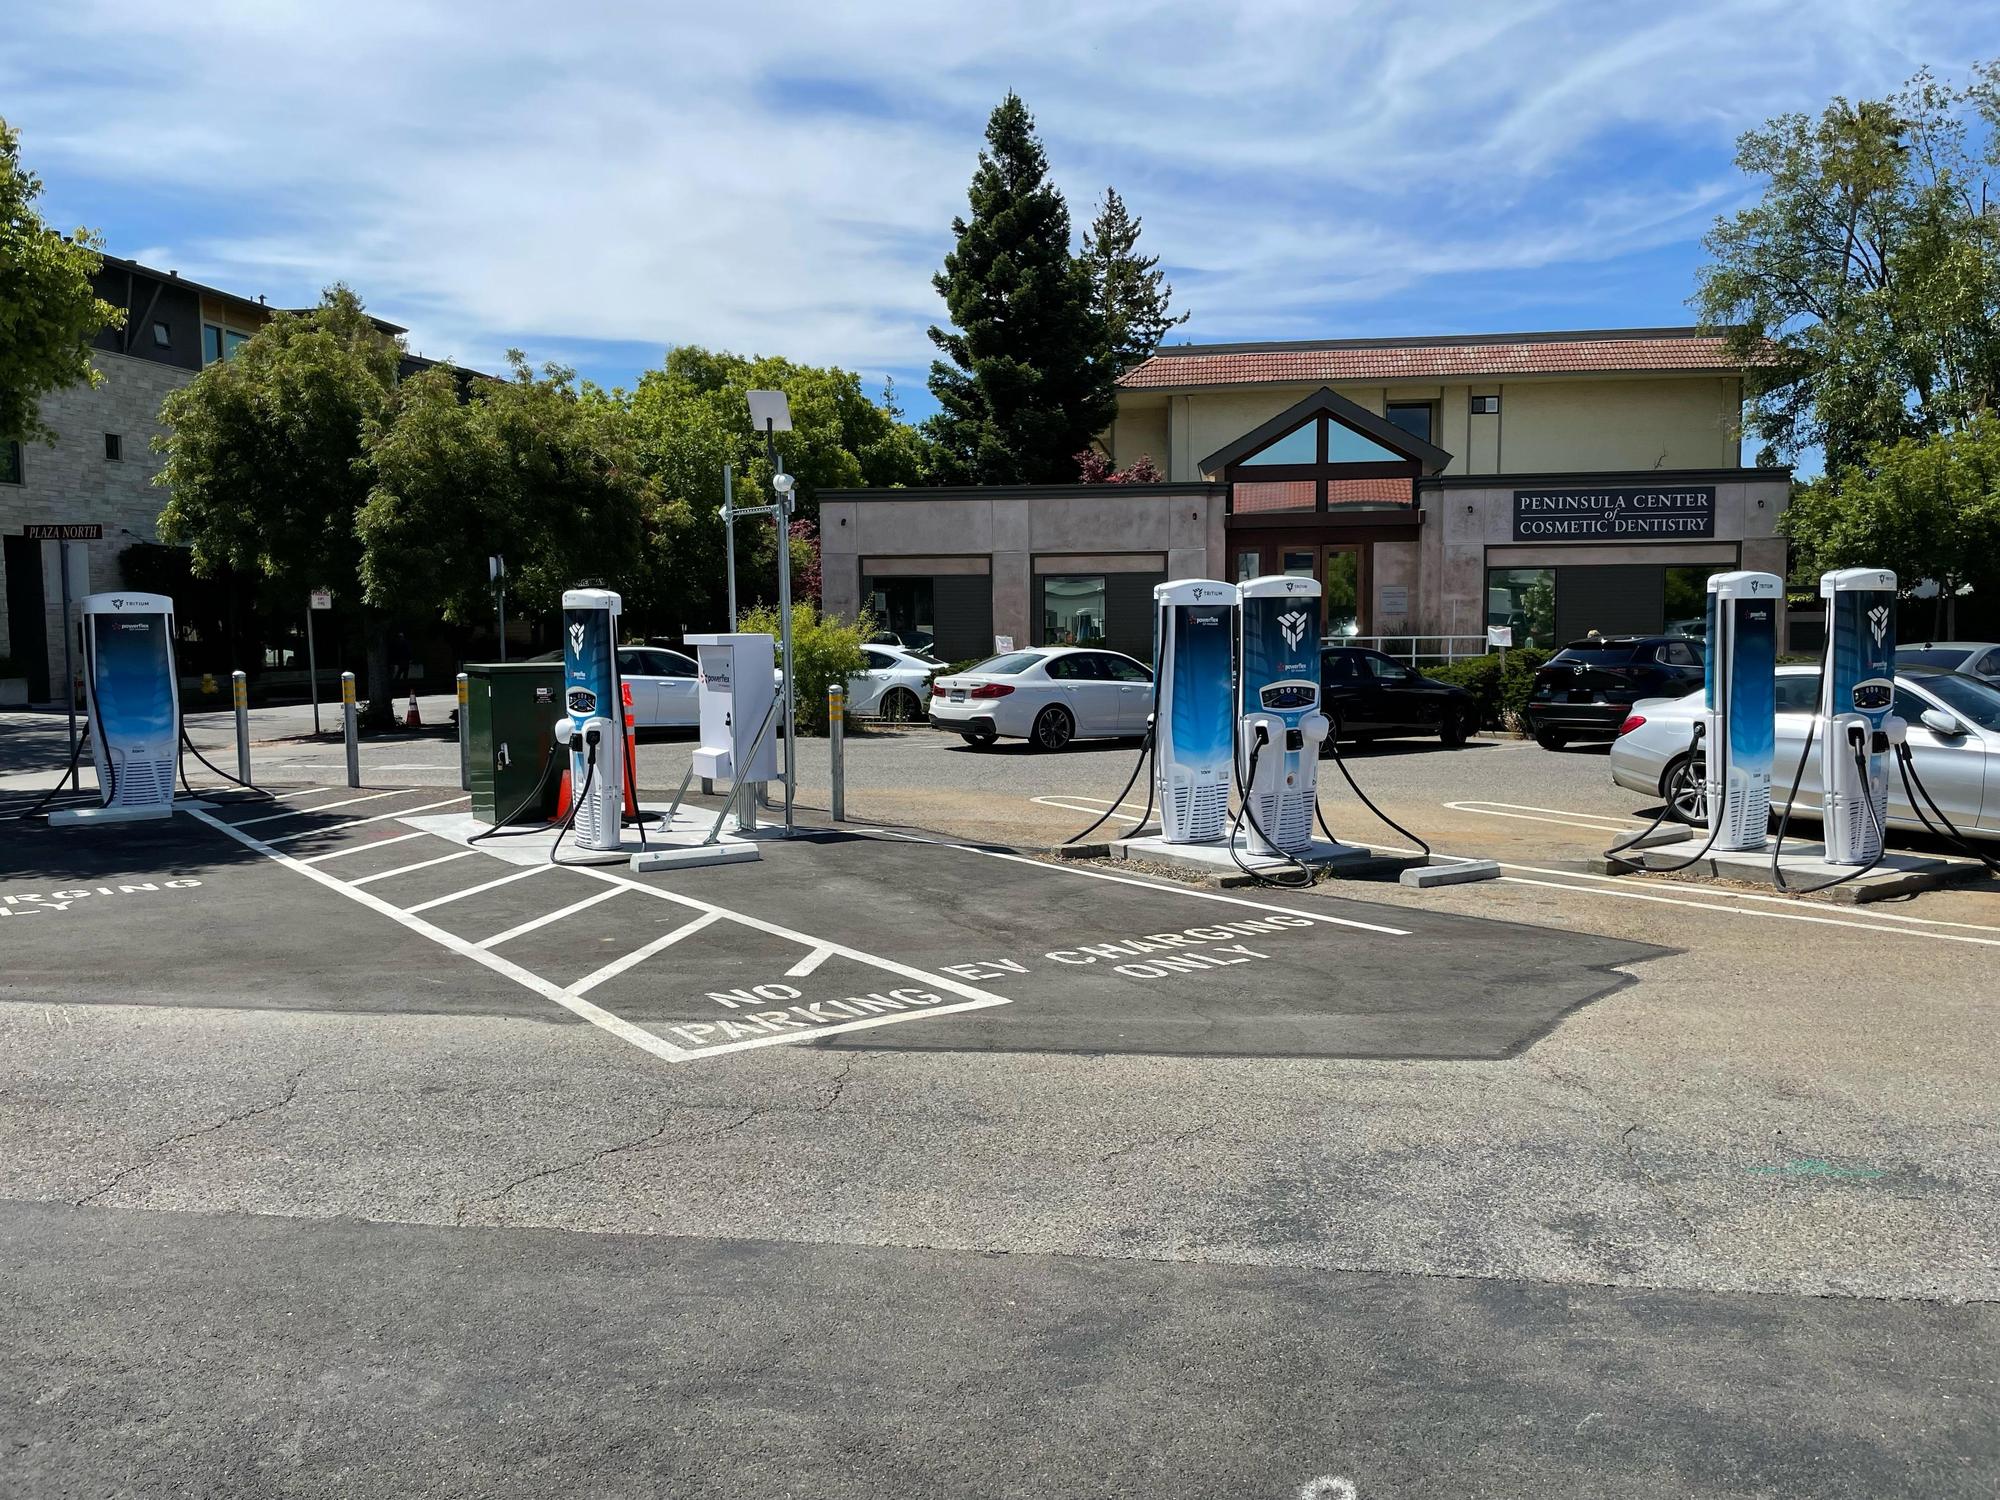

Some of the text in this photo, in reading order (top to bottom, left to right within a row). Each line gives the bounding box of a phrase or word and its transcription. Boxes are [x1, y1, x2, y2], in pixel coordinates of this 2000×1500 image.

[1520, 493, 1709, 510] PENINSULA CENTER
[1605, 507, 1620, 521] of
[29, 525, 98, 539] PLAZA NORTH
[1519, 517, 1708, 534] COSMETIC DENTISTRY
[1196, 616, 1219, 624] powerflex
[938, 915, 1315, 981] EV CHARGING
[1113, 944, 1272, 979] ONLY
[704, 983, 803, 1009] NO
[669, 987, 944, 1045] PARKING
